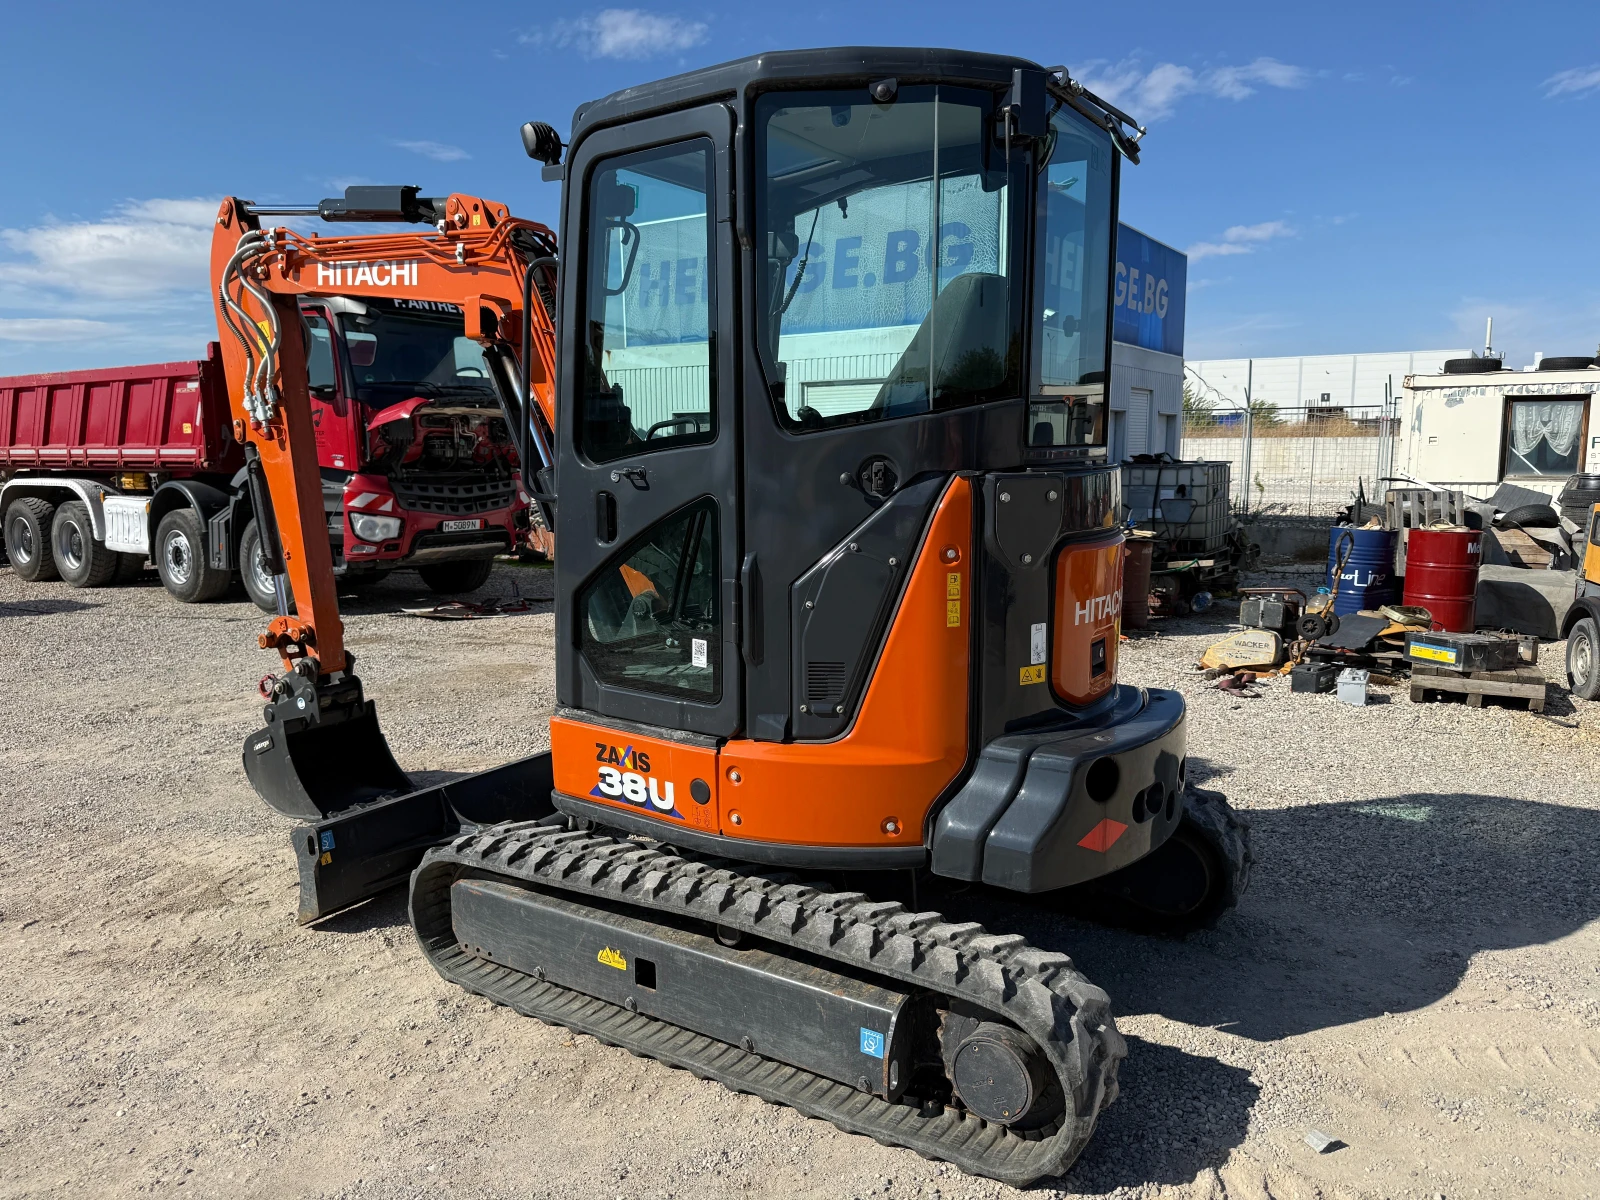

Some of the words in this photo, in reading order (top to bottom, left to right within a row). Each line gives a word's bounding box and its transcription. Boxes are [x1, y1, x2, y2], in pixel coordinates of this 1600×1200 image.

[317, 259, 418, 286] HITACHI
[1234, 640, 1270, 649] WACKER
[595, 742, 651, 773] ZAXIS
[597, 766, 675, 815] 38U
